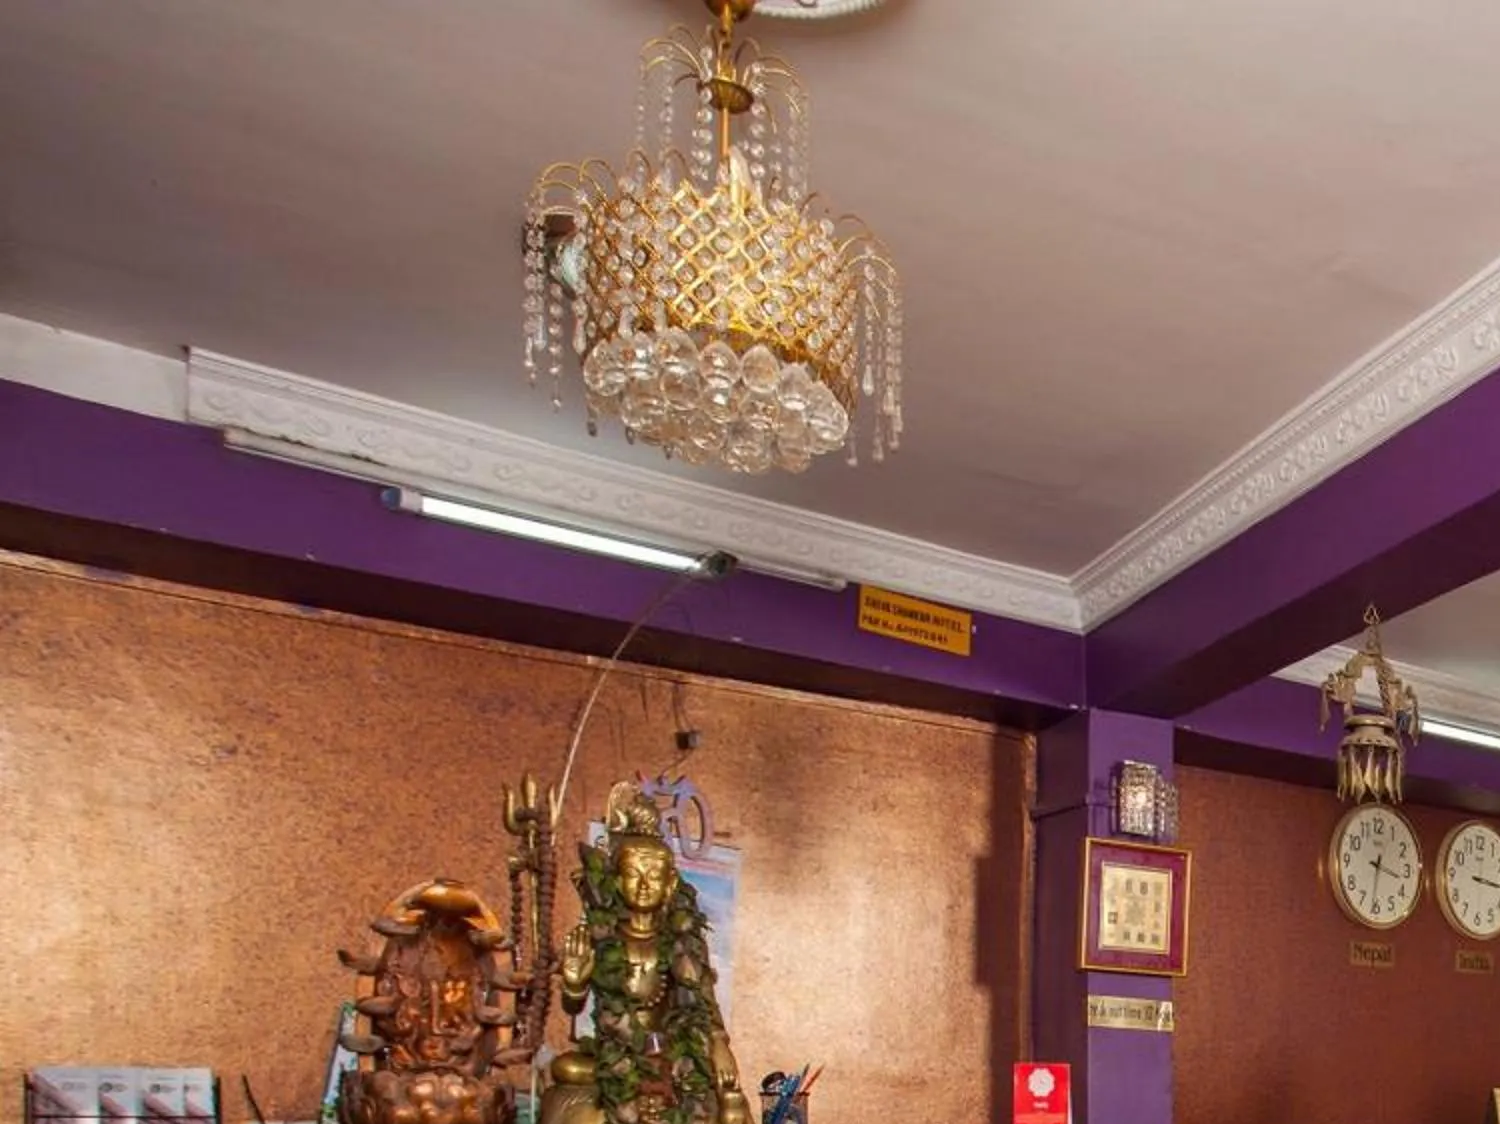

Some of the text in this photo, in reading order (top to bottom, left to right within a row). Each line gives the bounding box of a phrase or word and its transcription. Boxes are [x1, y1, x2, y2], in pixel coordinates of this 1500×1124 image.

[1360, 821, 1371, 839] 11
[1373, 817, 1384, 834] 12
[1349, 834, 1360, 851] 10
[1398, 842, 1407, 858] 2
[1464, 836, 1473, 854] 11
[1476, 835, 1485, 850] 12
[1344, 853, 1350, 868] 9
[1454, 850, 1465, 865] 10
[1404, 864, 1410, 878] 3
[1448, 867, 1456, 881] 9
[1347, 874, 1356, 891] 8
[1359, 890, 1367, 906] 7
[1398, 884, 1405, 899] 4
[1452, 888, 1459, 904] 8
[1372, 897, 1380, 914] 6
[1387, 895, 1395, 911] 5
[1462, 902, 1468, 916] 7
[1473, 911, 1481, 926] 6
[1487, 907, 1494, 923] 5
[1354, 943, 1392, 968] Nepal
